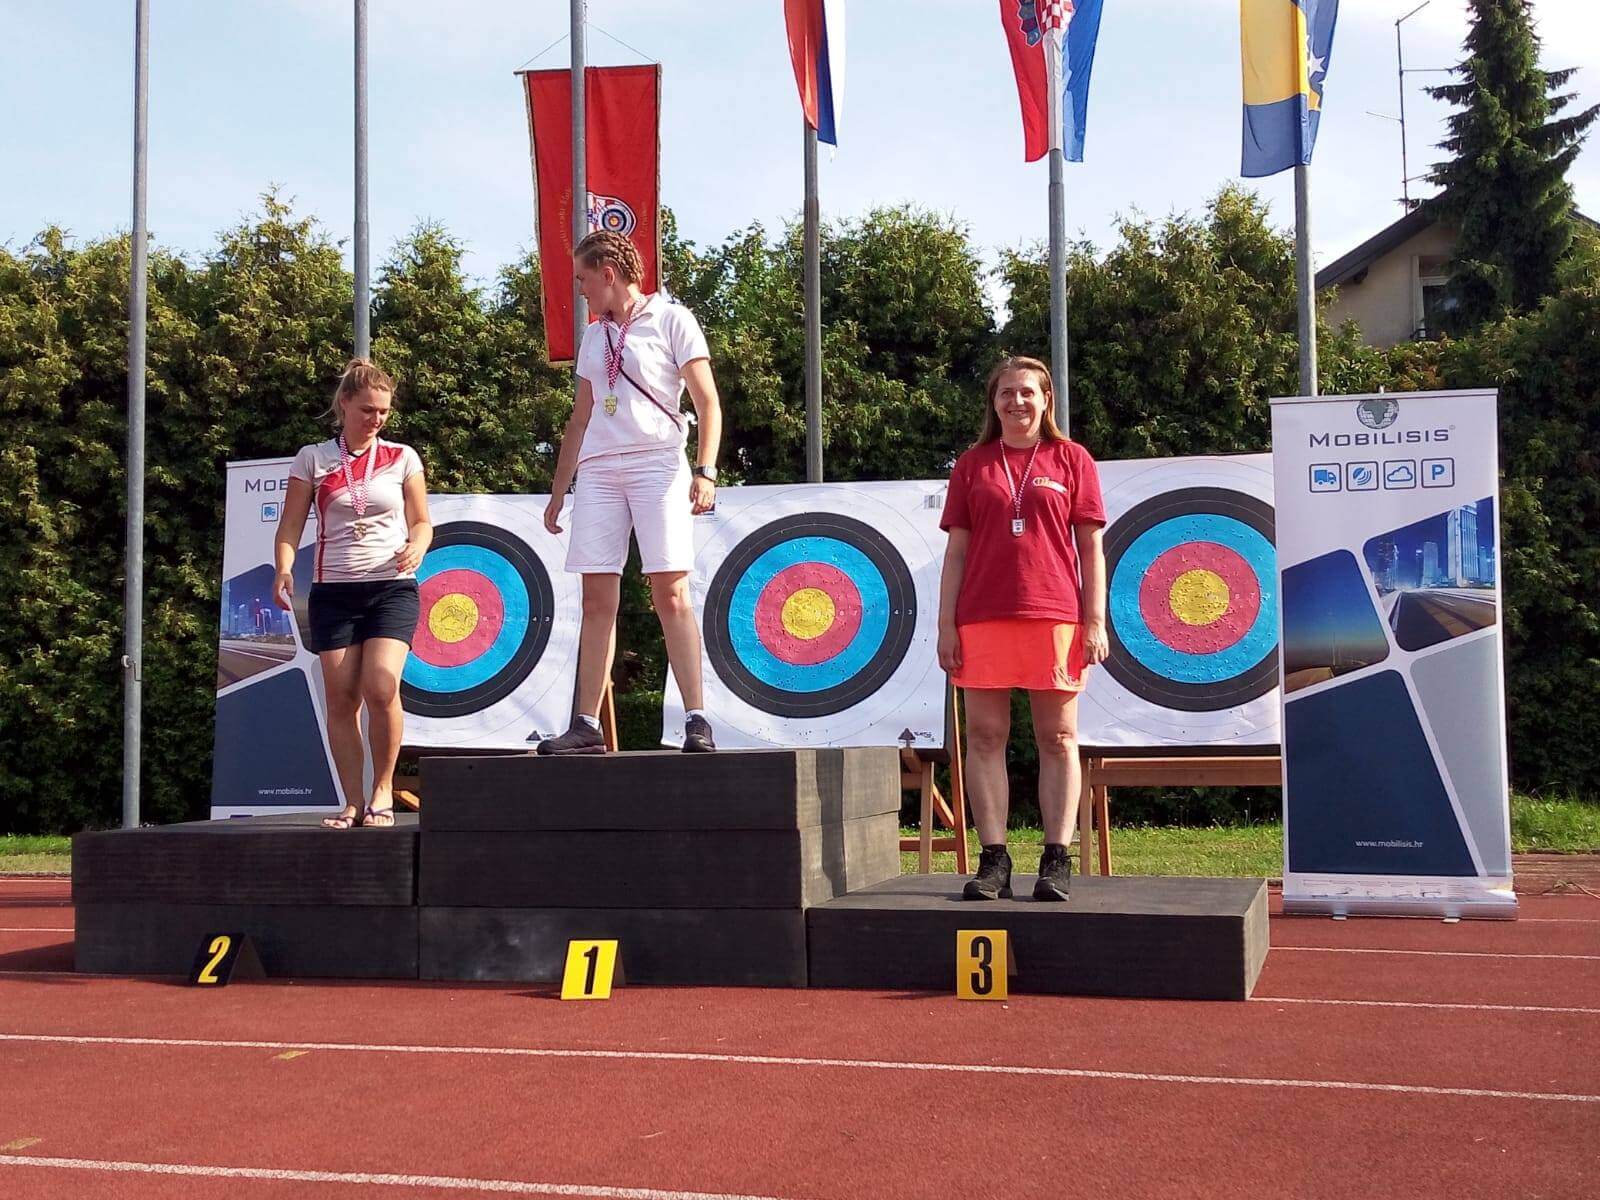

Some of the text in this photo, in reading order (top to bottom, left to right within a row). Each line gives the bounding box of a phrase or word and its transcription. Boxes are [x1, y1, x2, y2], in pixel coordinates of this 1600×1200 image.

[1309, 428, 1450, 448] MOBILISIS
[1431, 464, 1445, 481] P
[1354, 839, 1424, 848] www.mobilisis.hr
[198, 935, 231, 983] 2
[583, 946, 599, 995] 1
[970, 935, 993, 995] 3
